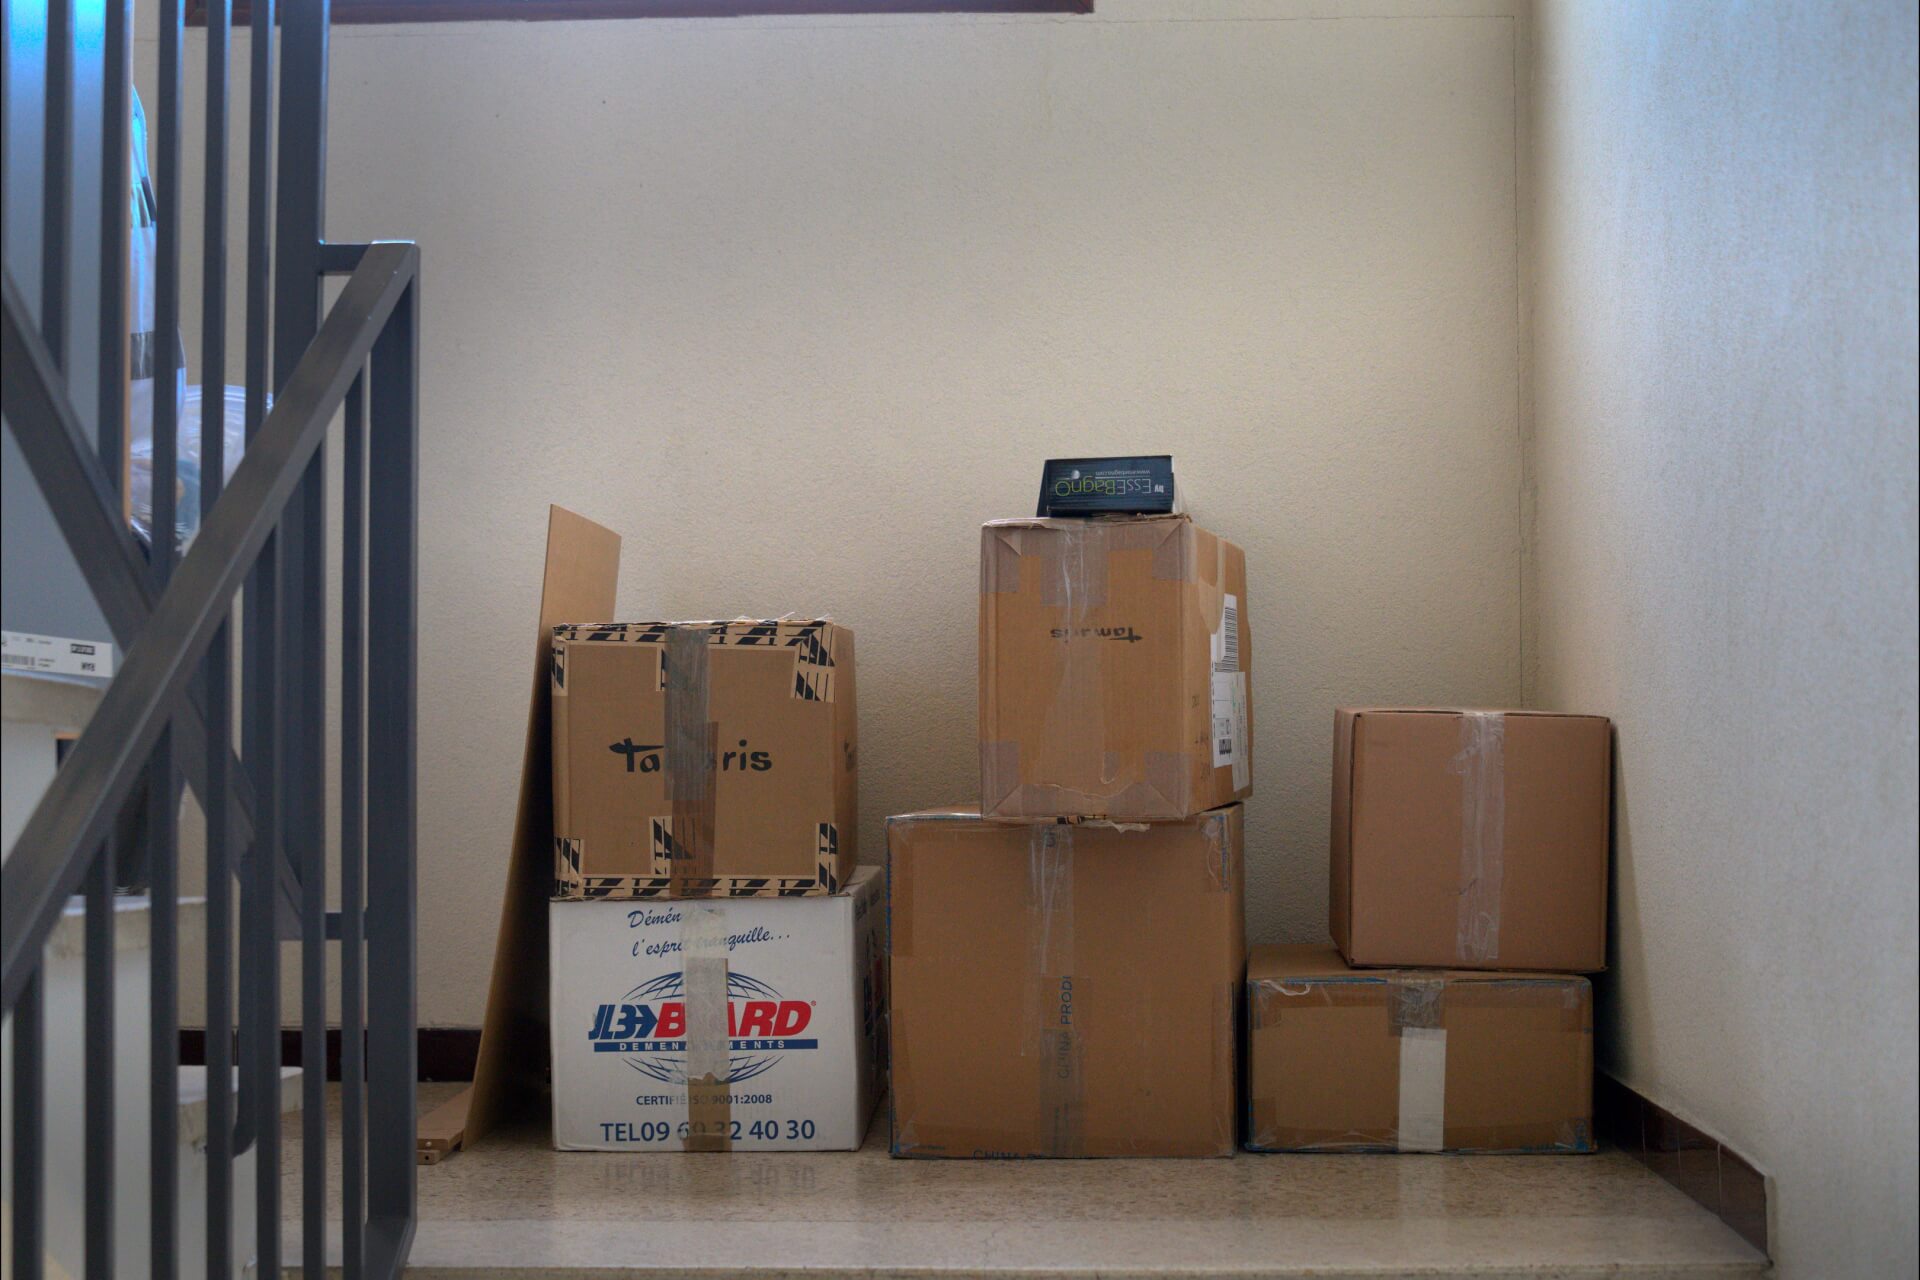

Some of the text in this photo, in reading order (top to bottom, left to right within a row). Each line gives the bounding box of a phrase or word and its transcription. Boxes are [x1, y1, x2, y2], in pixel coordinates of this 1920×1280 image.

[627, 907, 683, 929] Démén
[632, 938, 688, 958] l'espri
[619, 1040, 785, 1051] DEMENMENTS
[712, 1094, 773, 1105] 9001:2008
[749, 1120, 779, 1140] 40
[786, 1119, 816, 1140] 30
